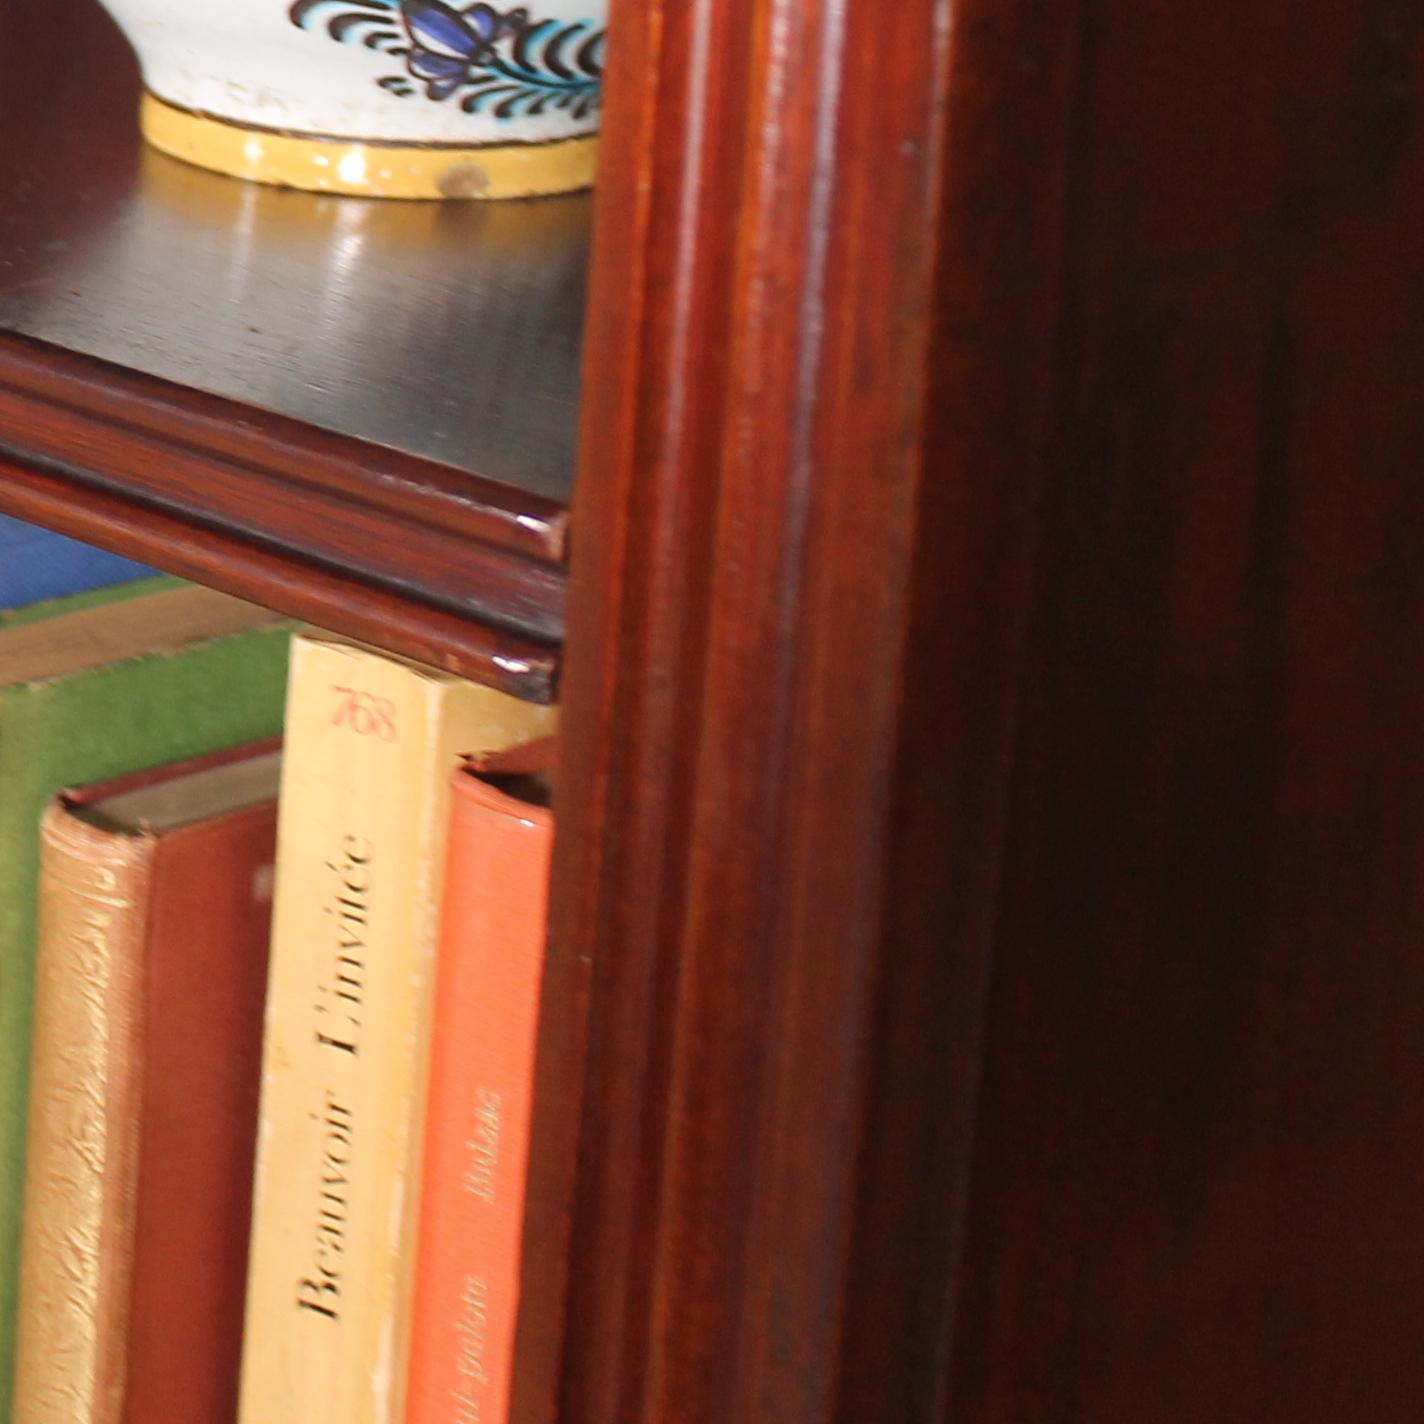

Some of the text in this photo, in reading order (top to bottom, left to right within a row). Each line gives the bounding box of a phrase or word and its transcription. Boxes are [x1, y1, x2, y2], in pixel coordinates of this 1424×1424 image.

[330, 684, 398, 742] 768
[296, 833, 376, 1324] Beauvoir L'invitée
